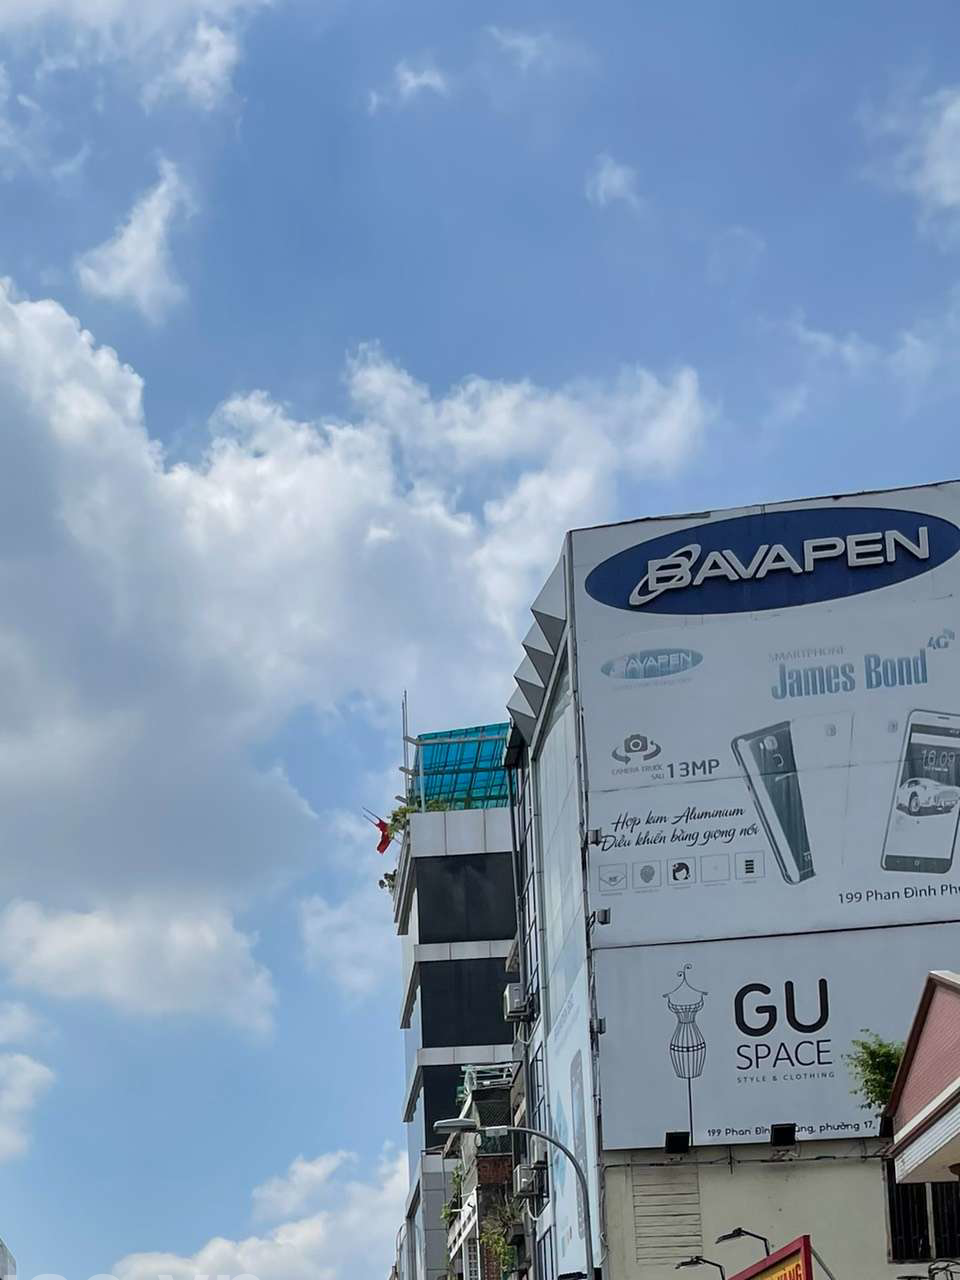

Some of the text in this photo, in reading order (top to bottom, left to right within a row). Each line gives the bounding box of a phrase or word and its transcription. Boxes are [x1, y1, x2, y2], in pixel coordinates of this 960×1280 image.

[630, 526, 930, 605] BAVAPEN
[771, 648, 928, 700] James Bond
[667, 759, 720, 779] 13MP
[671, 806, 745, 825] Aluminium
[838, 891, 863, 904] 199
[866, 889, 900, 902] Phan
[903, 885, 937, 899] Đình
[734, 978, 830, 1037] GU
[736, 1039, 833, 1071] SPACE
[737, 1075, 767, 1083] STYLE
[783, 1072, 835, 1082] CLOTHING
[707, 1128, 722, 1137] 199
[725, 1128, 751, 1137] Phan
